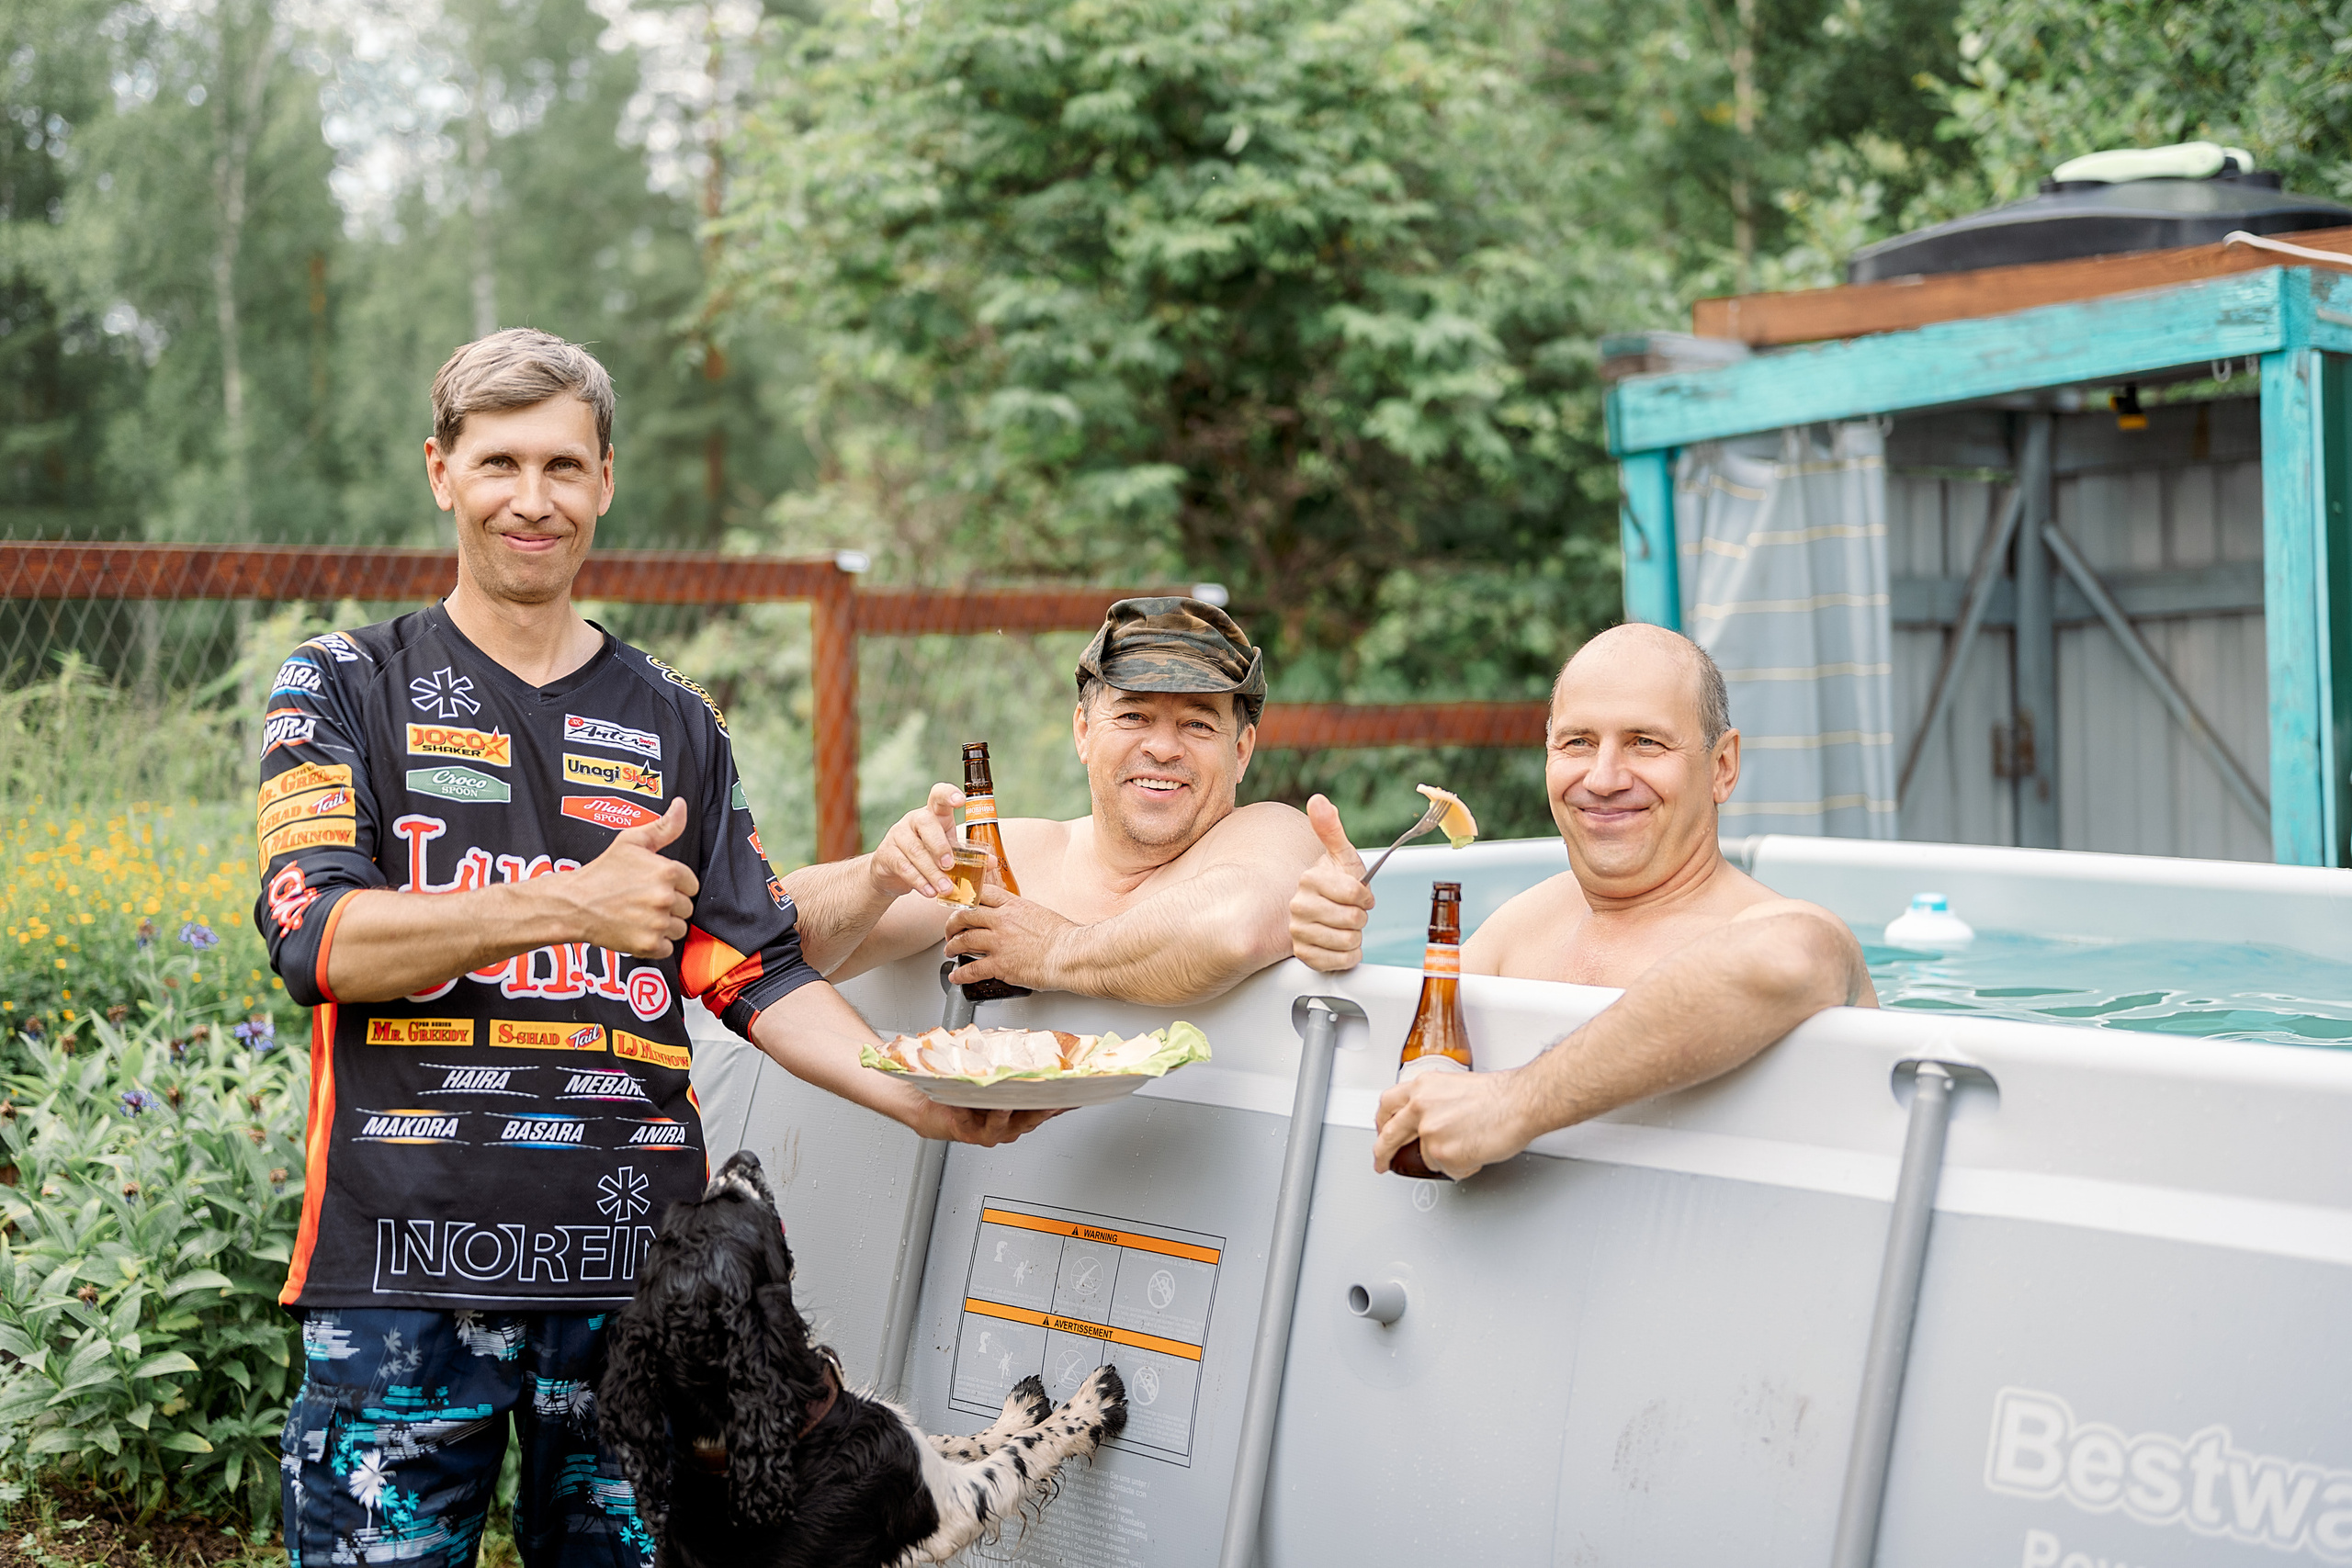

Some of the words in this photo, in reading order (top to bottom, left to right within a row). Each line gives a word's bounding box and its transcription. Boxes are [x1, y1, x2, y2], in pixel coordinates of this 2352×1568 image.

[422, 745, 481, 757] SHAKER
[432, 770, 488, 789] Croco
[568, 759, 622, 784] Unagi
[622, 767, 661, 795] Slug
[311, 786, 348, 816] Tail
[441, 785, 479, 797] SPOON
[583, 799, 642, 818] Maibe
[594, 813, 632, 826] SPOON
[569, 1022, 602, 1050] Tail
[617, 1033, 639, 1057] LJ
[640, 1043, 690, 1067] MINNOW
[441, 1069, 512, 1091] HAIRA
[361, 1116, 460, 1139] MAKORA
[500, 1120, 585, 1144] BASARA
[628, 1126, 686, 1144] ANIRA
[1083, 1228, 1118, 1243] WARNING
[1054, 1319, 1114, 1339] AVERTISSEMENT
